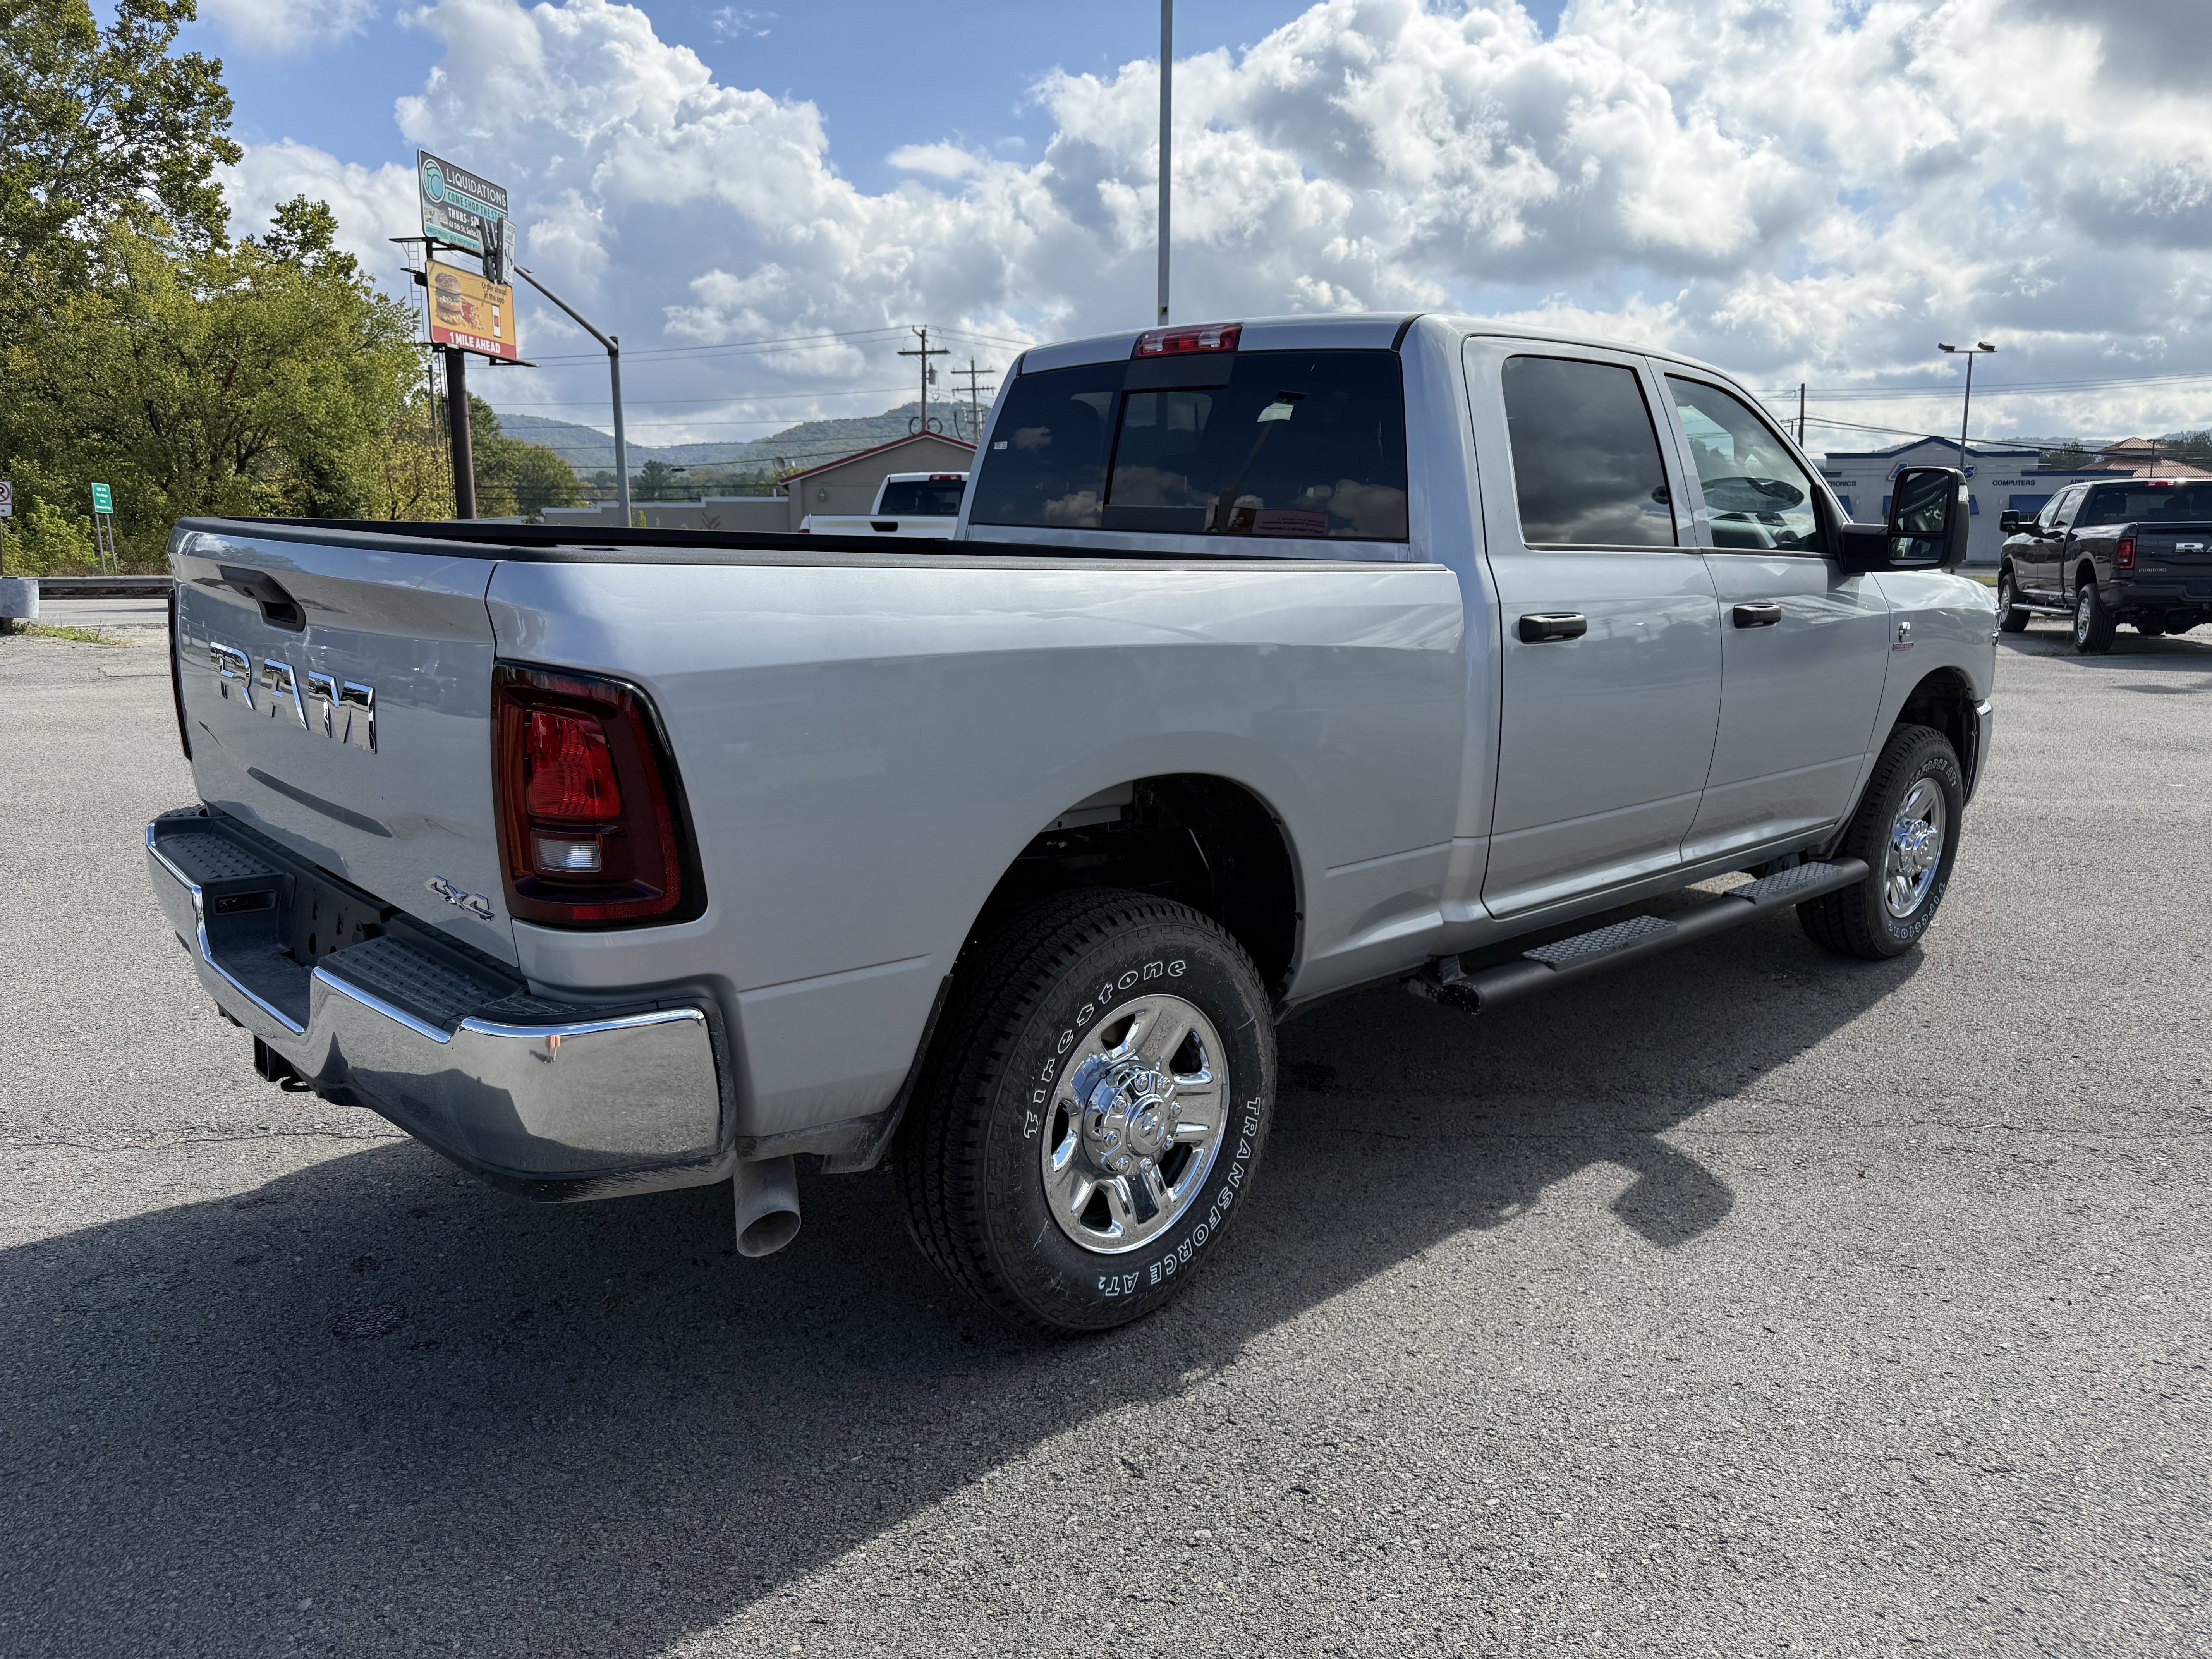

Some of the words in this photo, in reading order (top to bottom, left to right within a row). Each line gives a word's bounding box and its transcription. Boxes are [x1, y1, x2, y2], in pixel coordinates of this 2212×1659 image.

[446, 168, 507, 207] LIQUIDATIONS
[448, 191, 464, 207] COME
[465, 198, 479, 213] SHOP
[480, 205, 490, 218] THE
[448, 207, 467, 223] THURS
[450, 332, 454, 343] 1
[455, 333, 474, 348] MILE
[475, 338, 501, 354] AHEAD
[210, 641, 376, 754] RAM
[1024, 960, 1187, 1139] Firestone
[1150, 1097, 1261, 1285] TRANSFORCE
